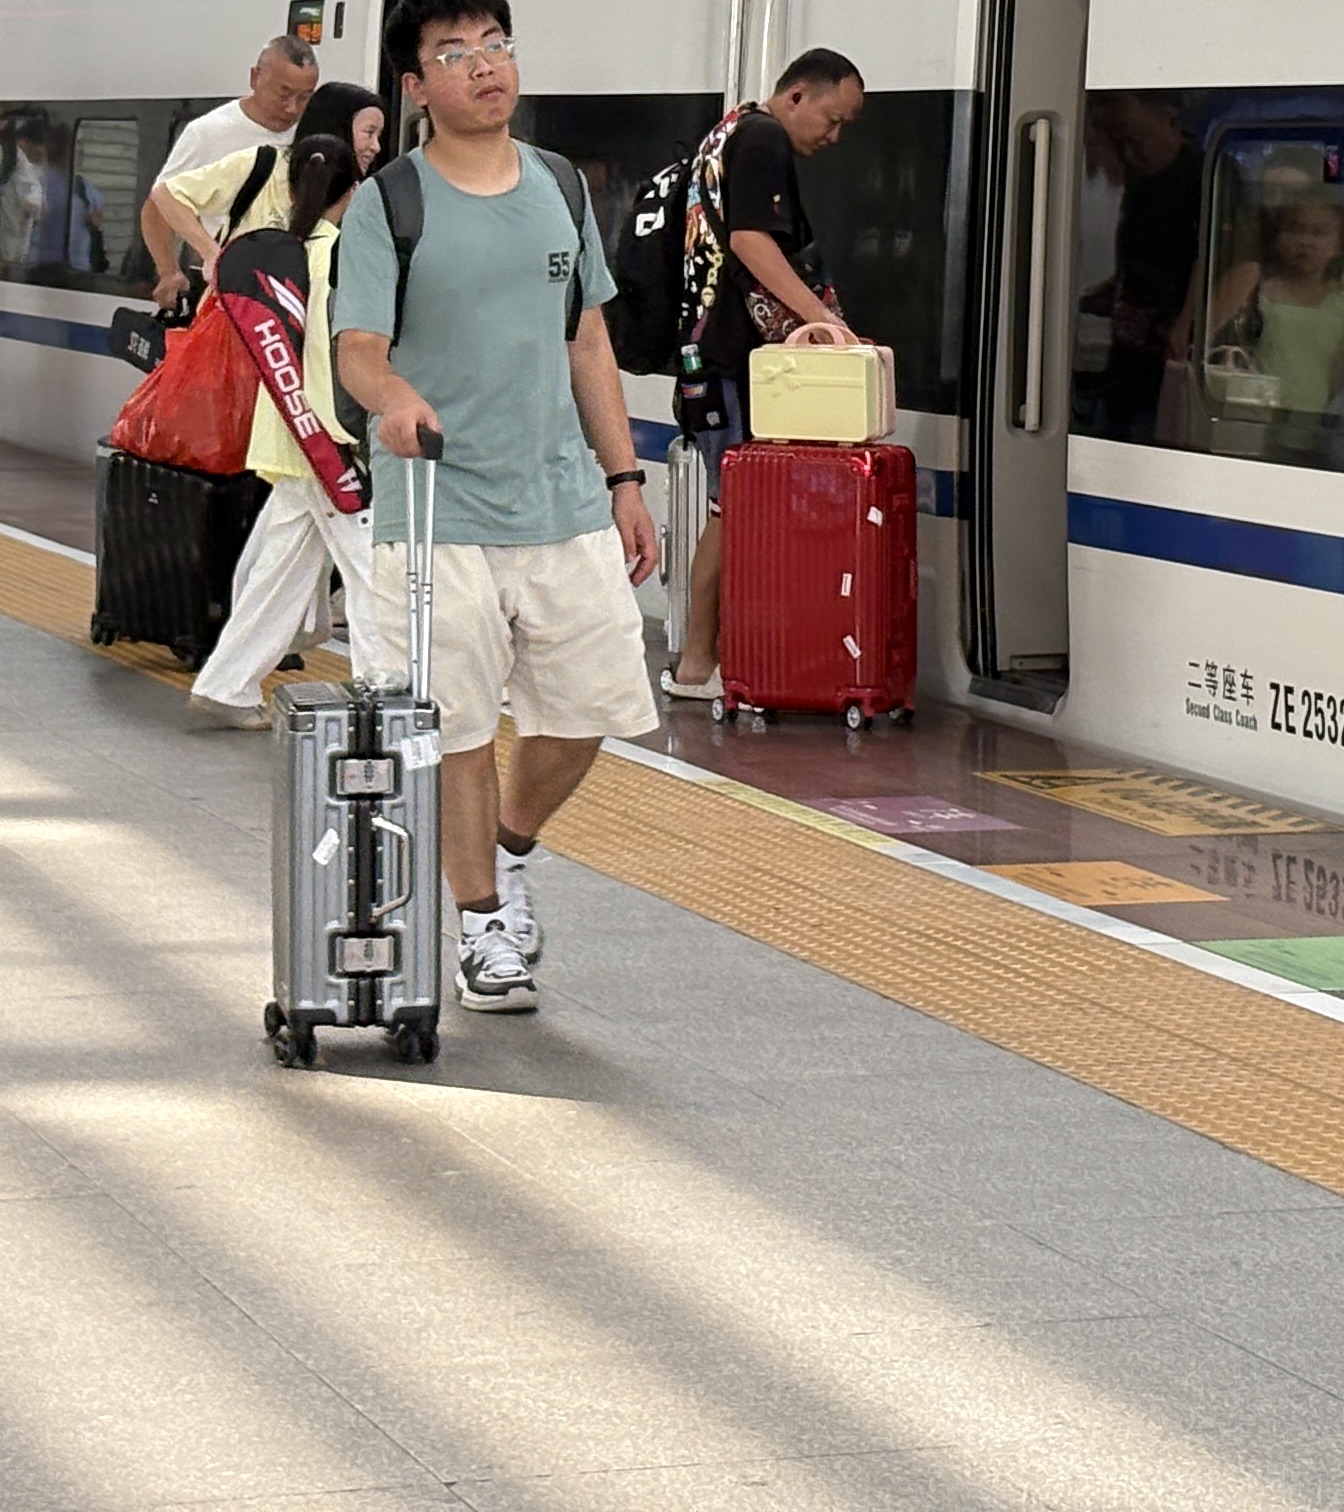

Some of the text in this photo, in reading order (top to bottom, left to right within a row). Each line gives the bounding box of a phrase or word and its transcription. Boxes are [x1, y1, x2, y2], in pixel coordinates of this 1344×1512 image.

[548, 251, 570, 277] 55
[1187, 659, 1255, 706] 二等座车
[1185, 698, 1258, 732] Second Class Coach
[1269, 682, 1296, 735] ZE
